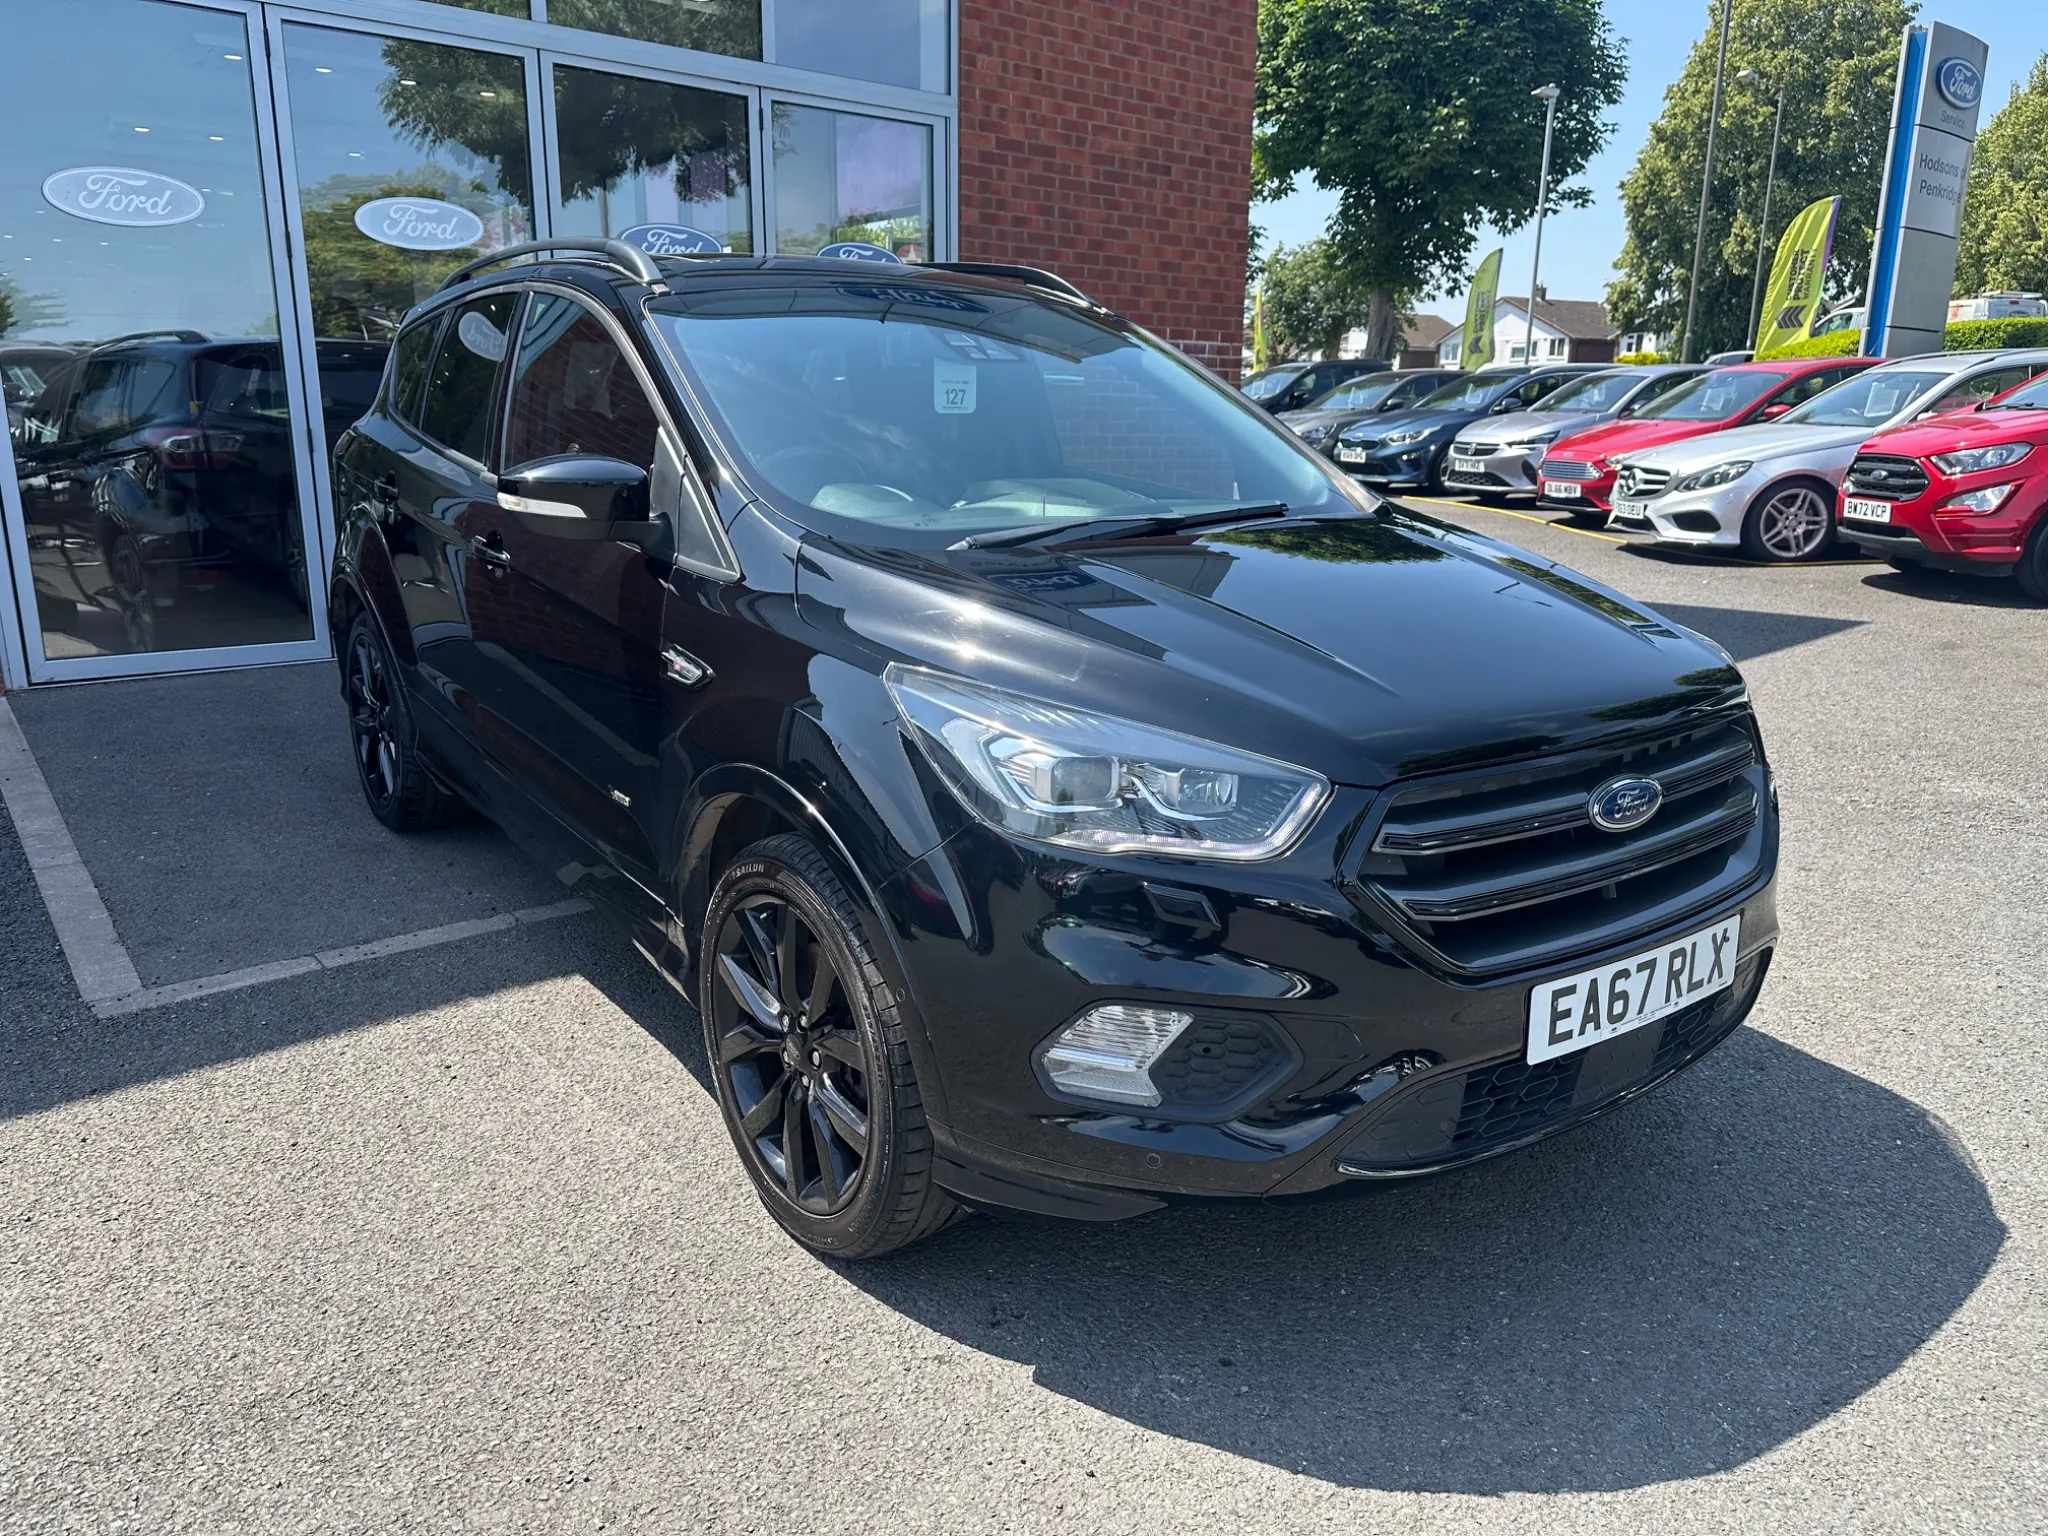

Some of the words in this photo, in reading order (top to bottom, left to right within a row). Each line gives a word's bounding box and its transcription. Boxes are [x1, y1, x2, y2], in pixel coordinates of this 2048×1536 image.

[1950, 65, 1977, 100] Ford
[1940, 110, 1965, 130] Service
[1919, 152, 1959, 178] Hodsons
[78, 174, 173, 215] Ford
[1919, 179, 1961, 207] Penkridge
[383, 204, 458, 239] Ford
[945, 388, 967, 405] 127
[1847, 501, 1869, 516] BW72
[1870, 503, 1887, 518] VCP
[1614, 788, 1650, 819] Ford
[736, 863, 765, 878] SAILUN
[1548, 957, 1658, 1046] EA67
[1664, 927, 1729, 1004] RLX
